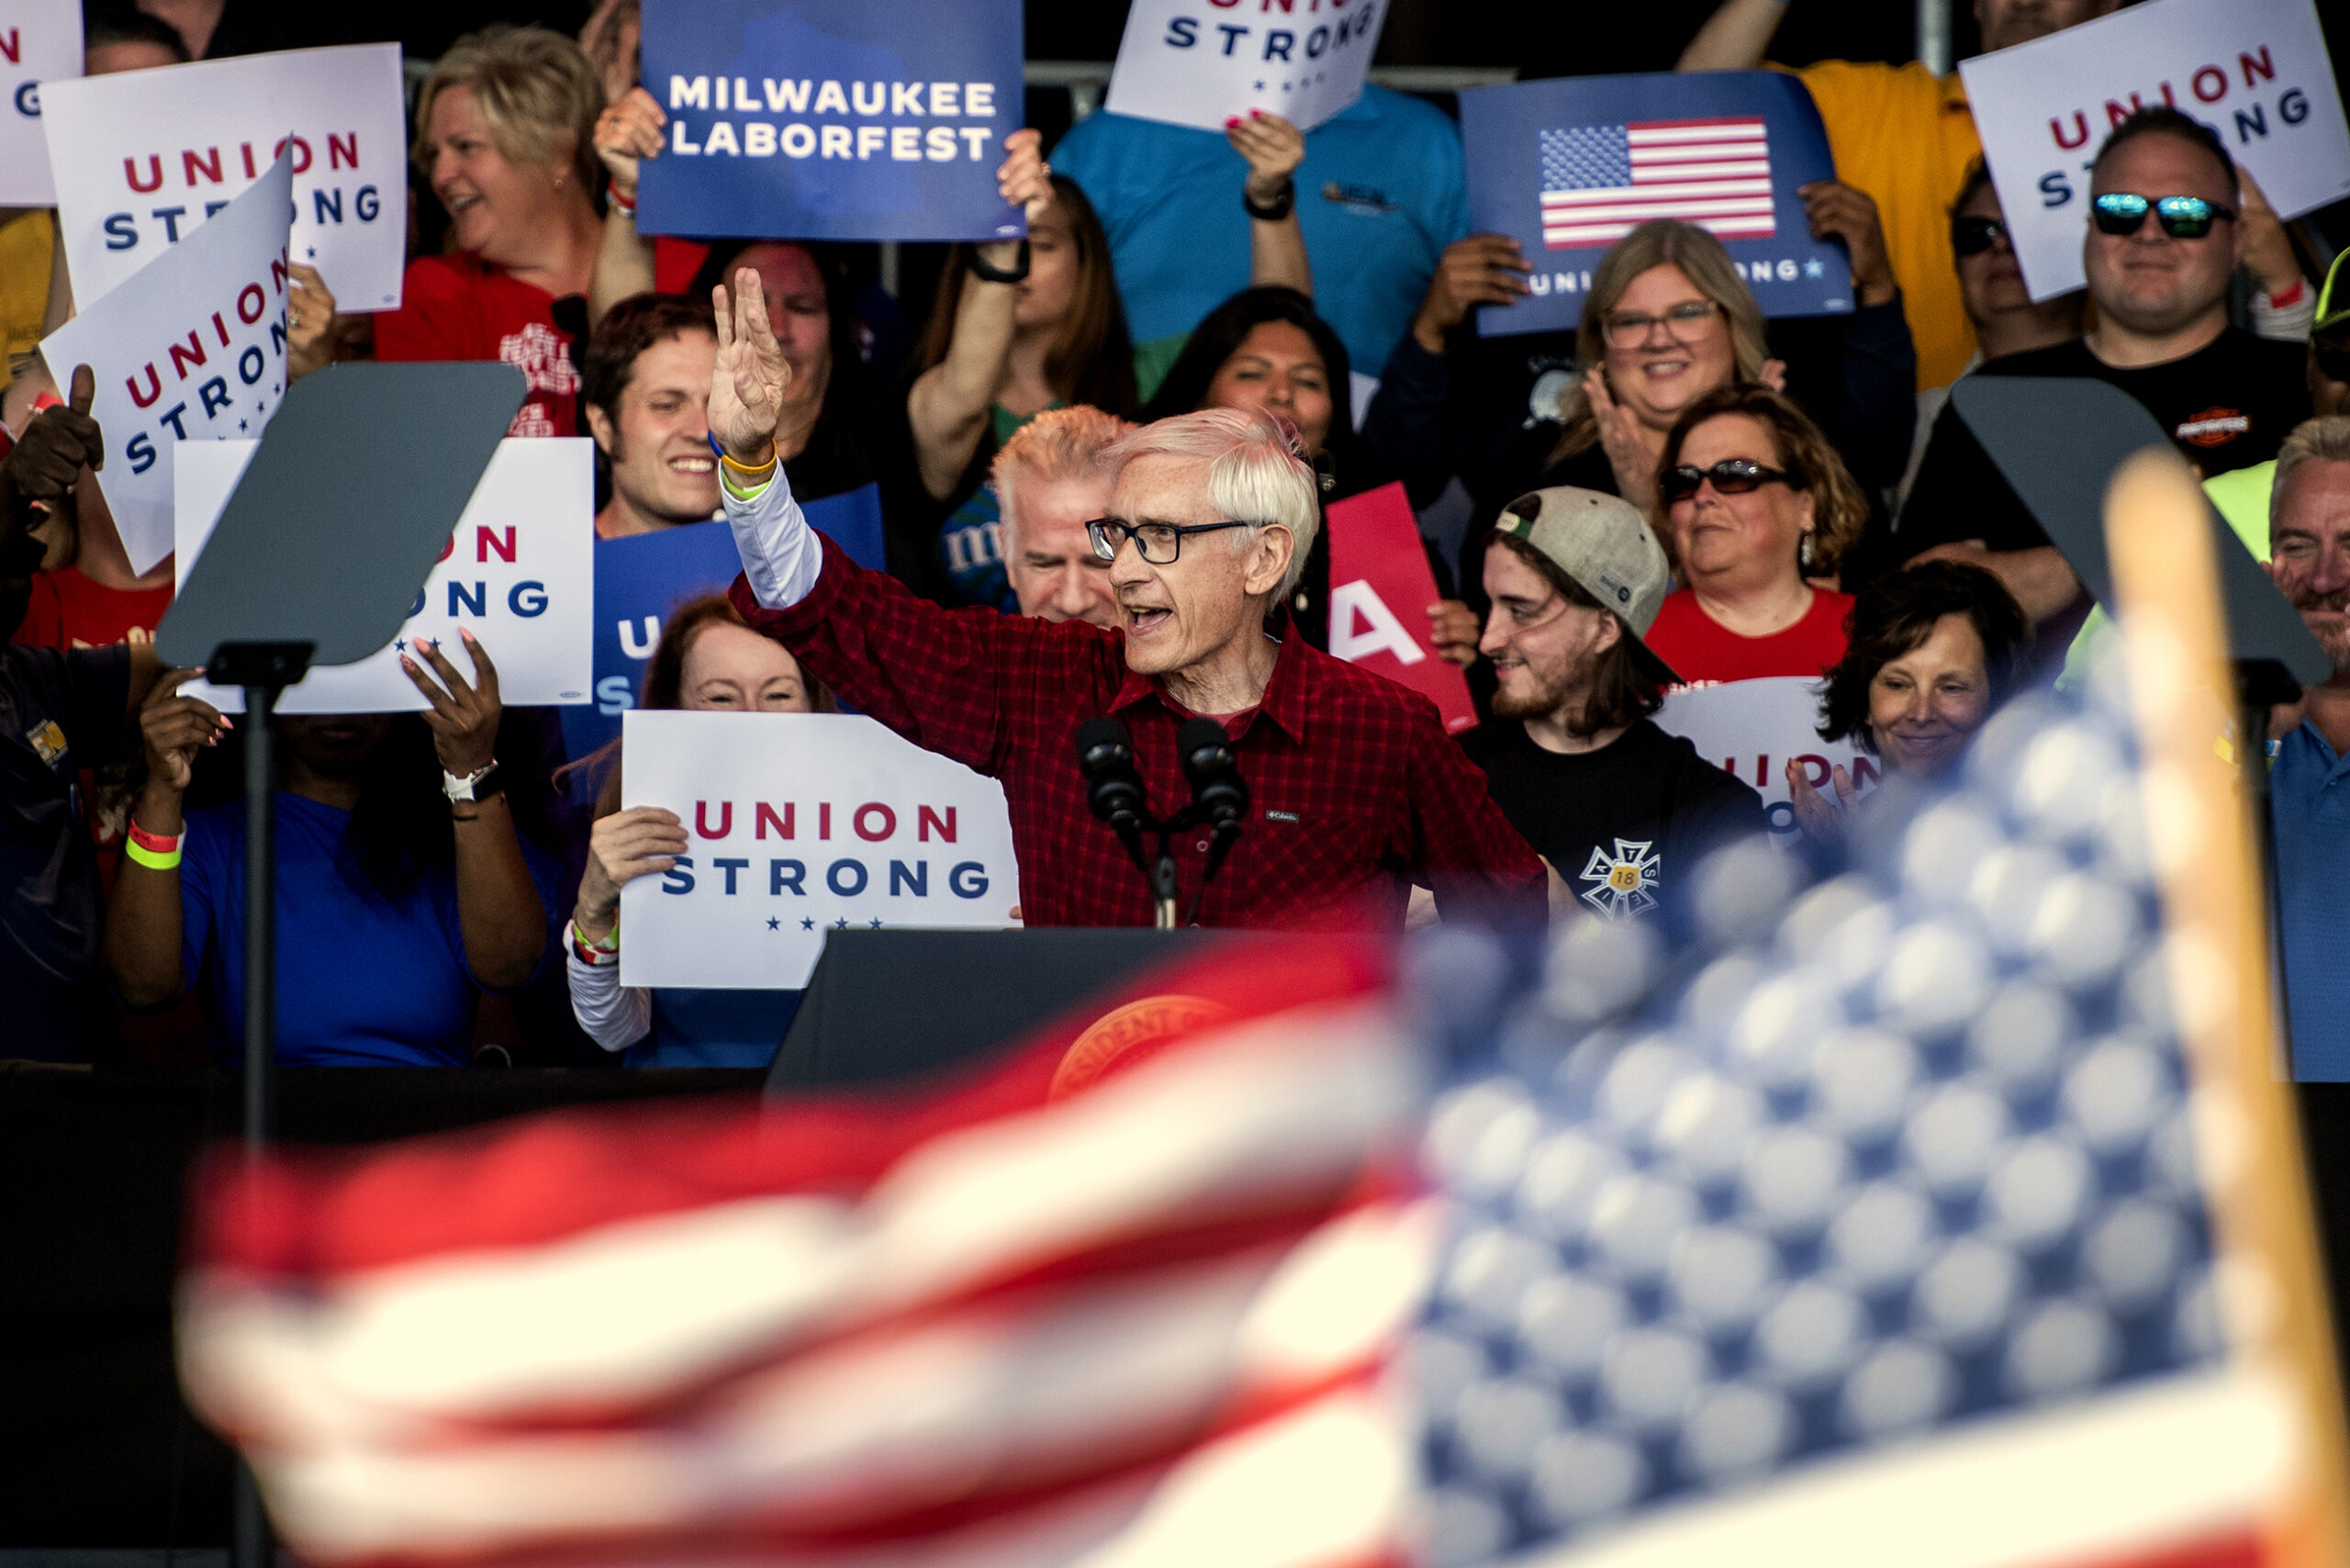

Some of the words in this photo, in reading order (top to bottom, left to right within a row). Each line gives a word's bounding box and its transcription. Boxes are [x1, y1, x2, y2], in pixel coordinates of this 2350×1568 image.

[670, 74, 996, 118] MILWAUKEE
[124, 131, 359, 194] UNION
[672, 121, 992, 162] LABORFEST
[104, 185, 380, 252] STNG
[695, 801, 957, 843] UNION
[662, 856, 990, 899] STRONG
[1617, 871, 1635, 885] 18
